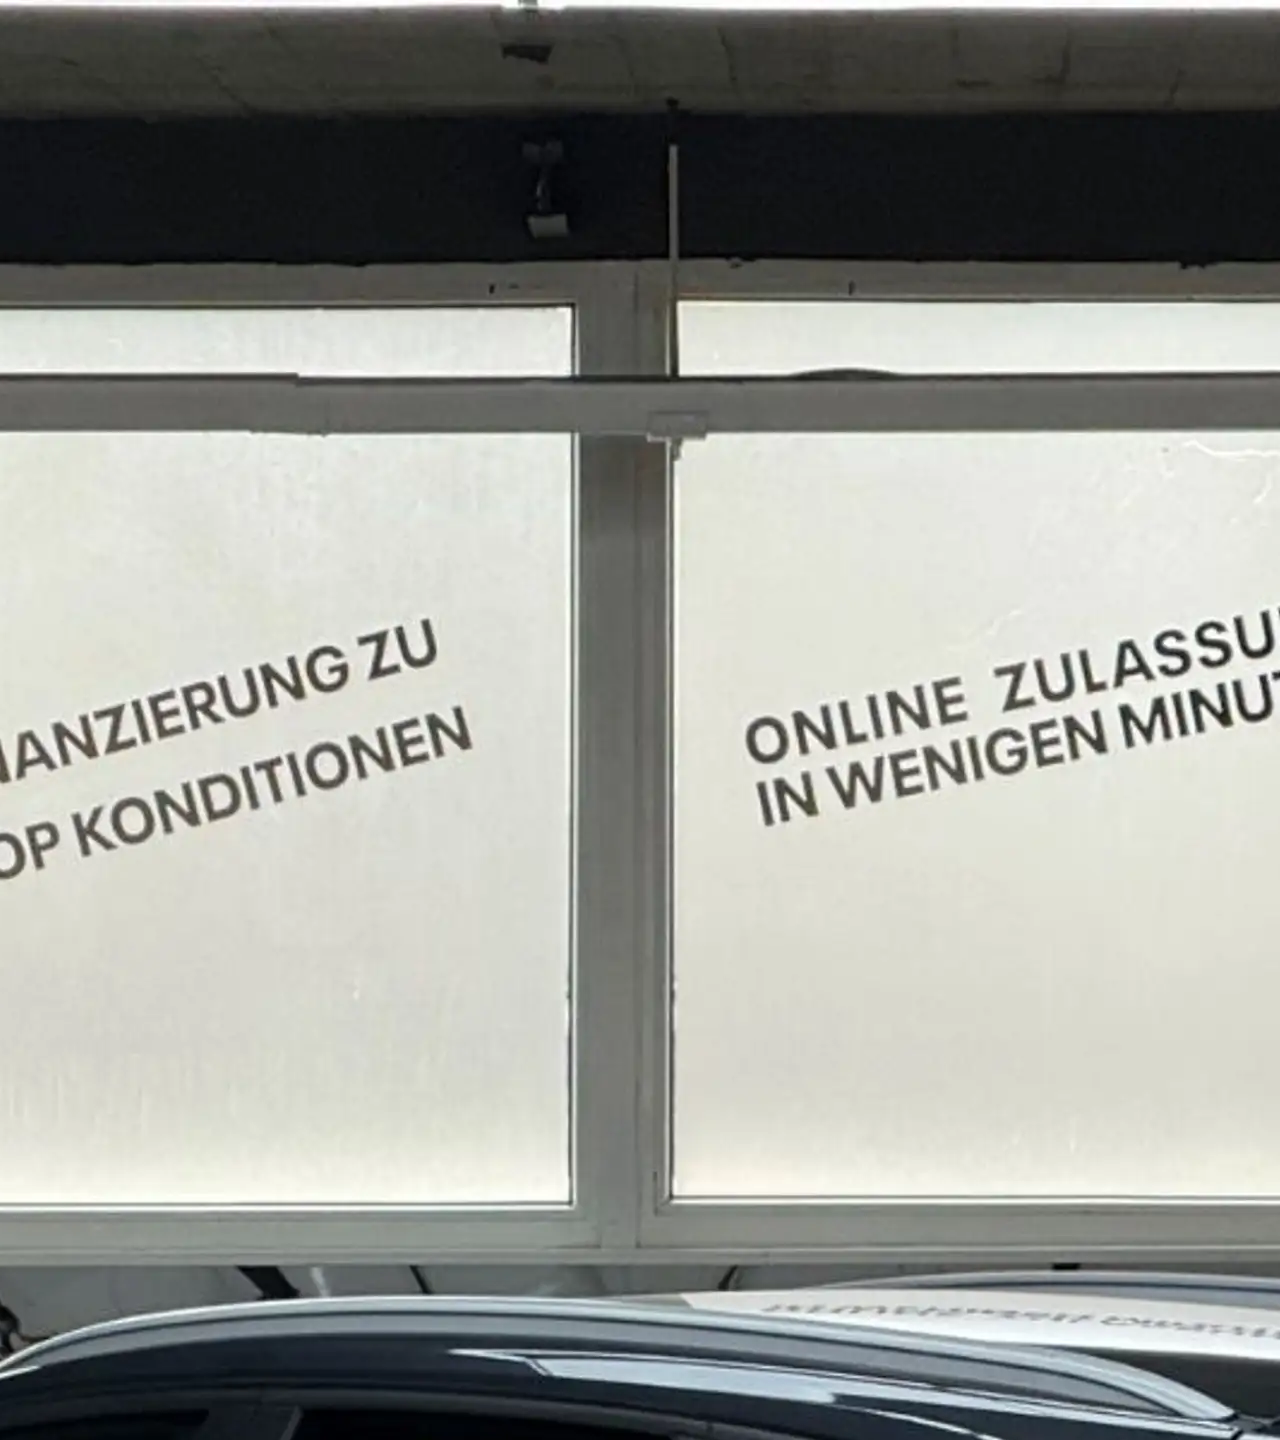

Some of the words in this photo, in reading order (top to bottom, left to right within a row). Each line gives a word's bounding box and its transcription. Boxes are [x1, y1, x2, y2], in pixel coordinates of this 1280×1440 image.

[358, 619, 436, 680] ZU
[746, 678, 967, 764] ONLINE
[757, 772, 818, 826] IN
[826, 710, 1107, 808] WENIGEN
[72, 706, 471, 856] KONDITIONEN
